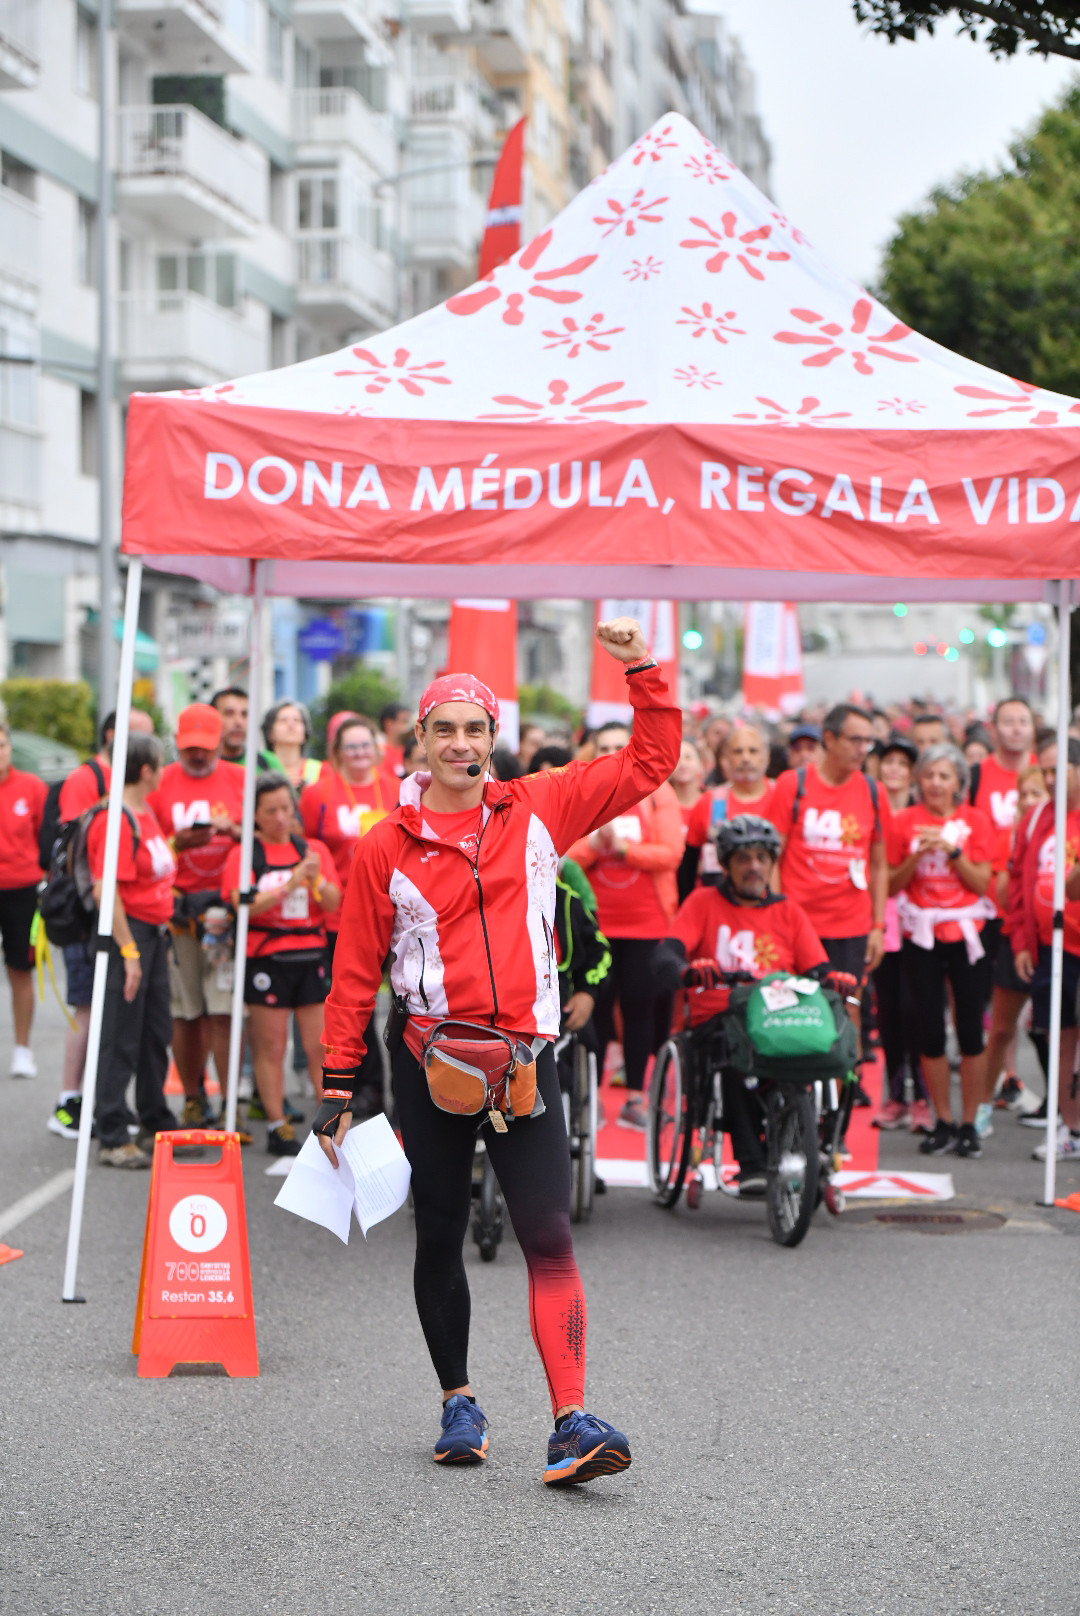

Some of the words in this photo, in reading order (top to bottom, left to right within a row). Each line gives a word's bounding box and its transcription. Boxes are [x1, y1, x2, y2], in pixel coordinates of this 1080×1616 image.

[204, 452, 391, 510] DONA
[410, 453, 675, 515] MÉDULA,
[700, 461, 940, 524] REGALA
[190, 1213, 206, 1238] 0
[165, 1262, 199, 1281] 700
[161, 1290, 205, 1303] Restan
